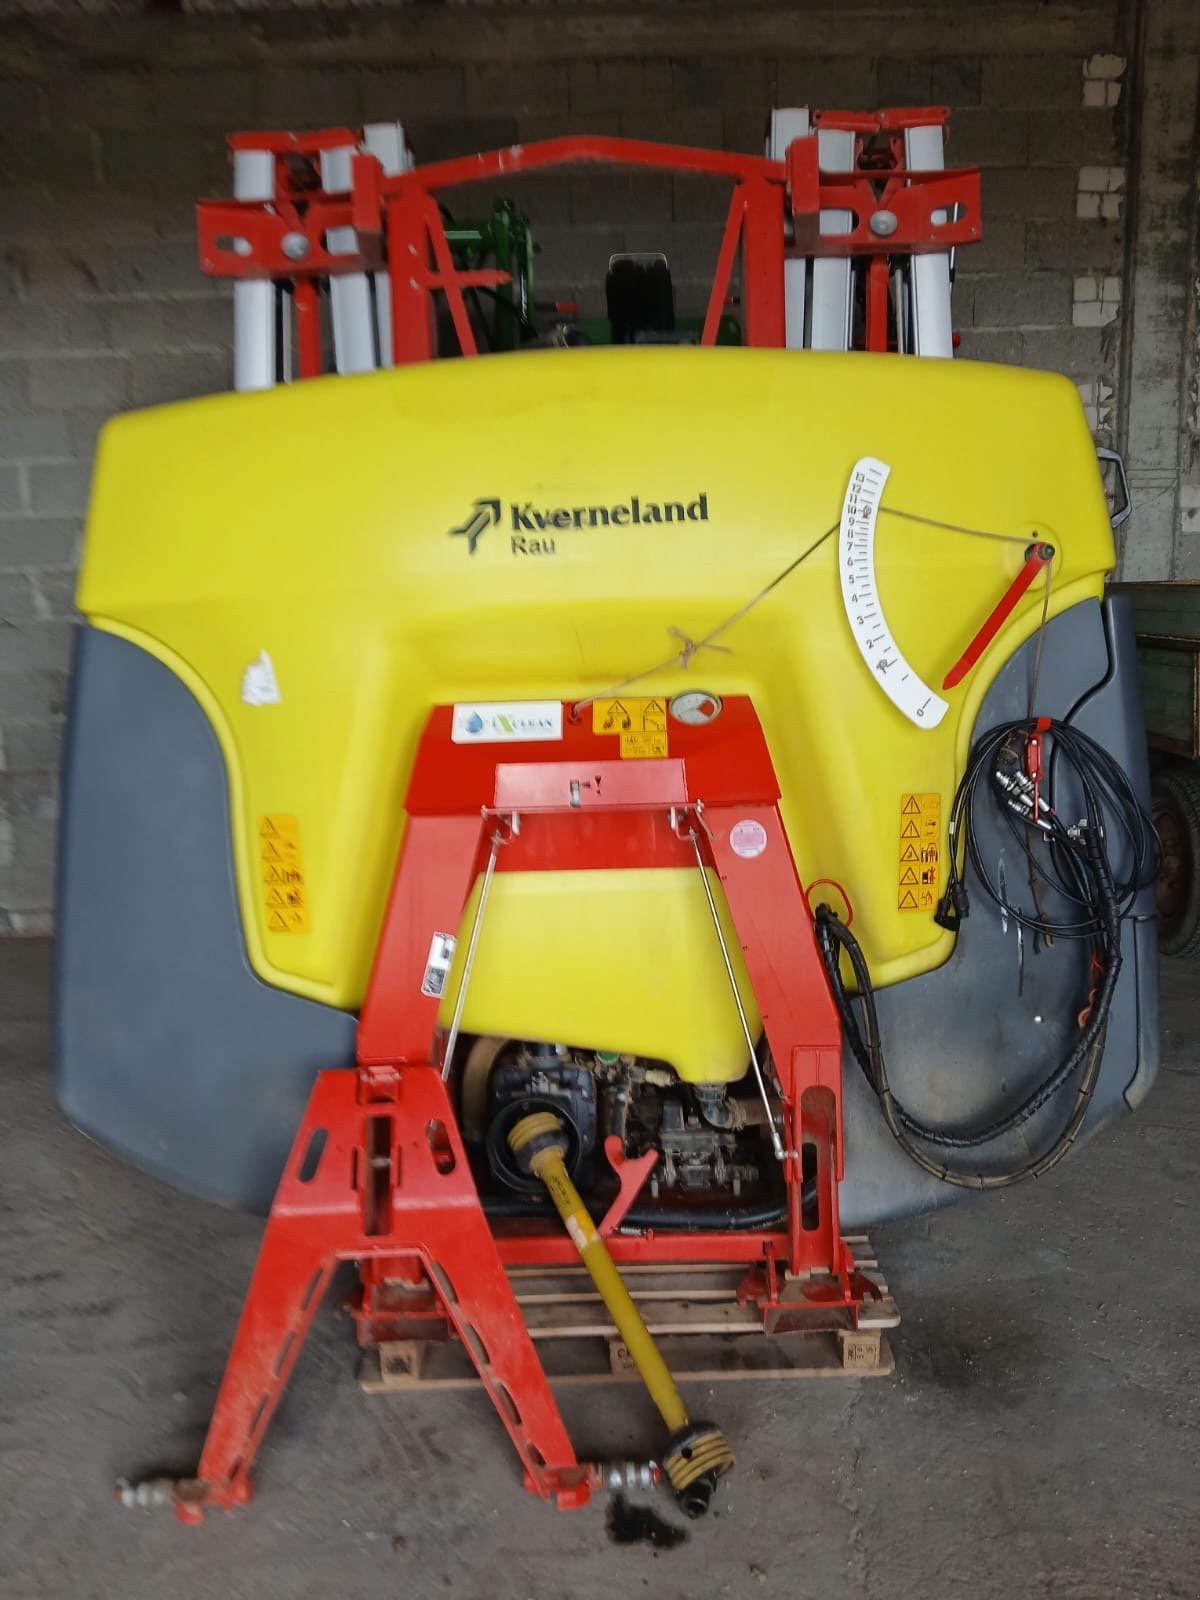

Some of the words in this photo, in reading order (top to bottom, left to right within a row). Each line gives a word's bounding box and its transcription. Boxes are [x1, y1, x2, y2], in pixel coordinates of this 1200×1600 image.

[855, 472, 866, 483] 13
[852, 483, 862, 494] 12
[849, 494, 858, 504] 11
[511, 491, 709, 531] Kverneland
[847, 504, 857, 515] 10
[848, 517, 855, 527] 9
[511, 535, 556, 556] Rau
[847, 541, 854, 551] 7
[847, 556, 854, 566] 6
[848, 574, 855, 585] 5
[851, 593, 859, 604] 4
[856, 615, 864, 625] 3
[866, 639, 874, 650] 2
[916, 708, 925, 718] 0
